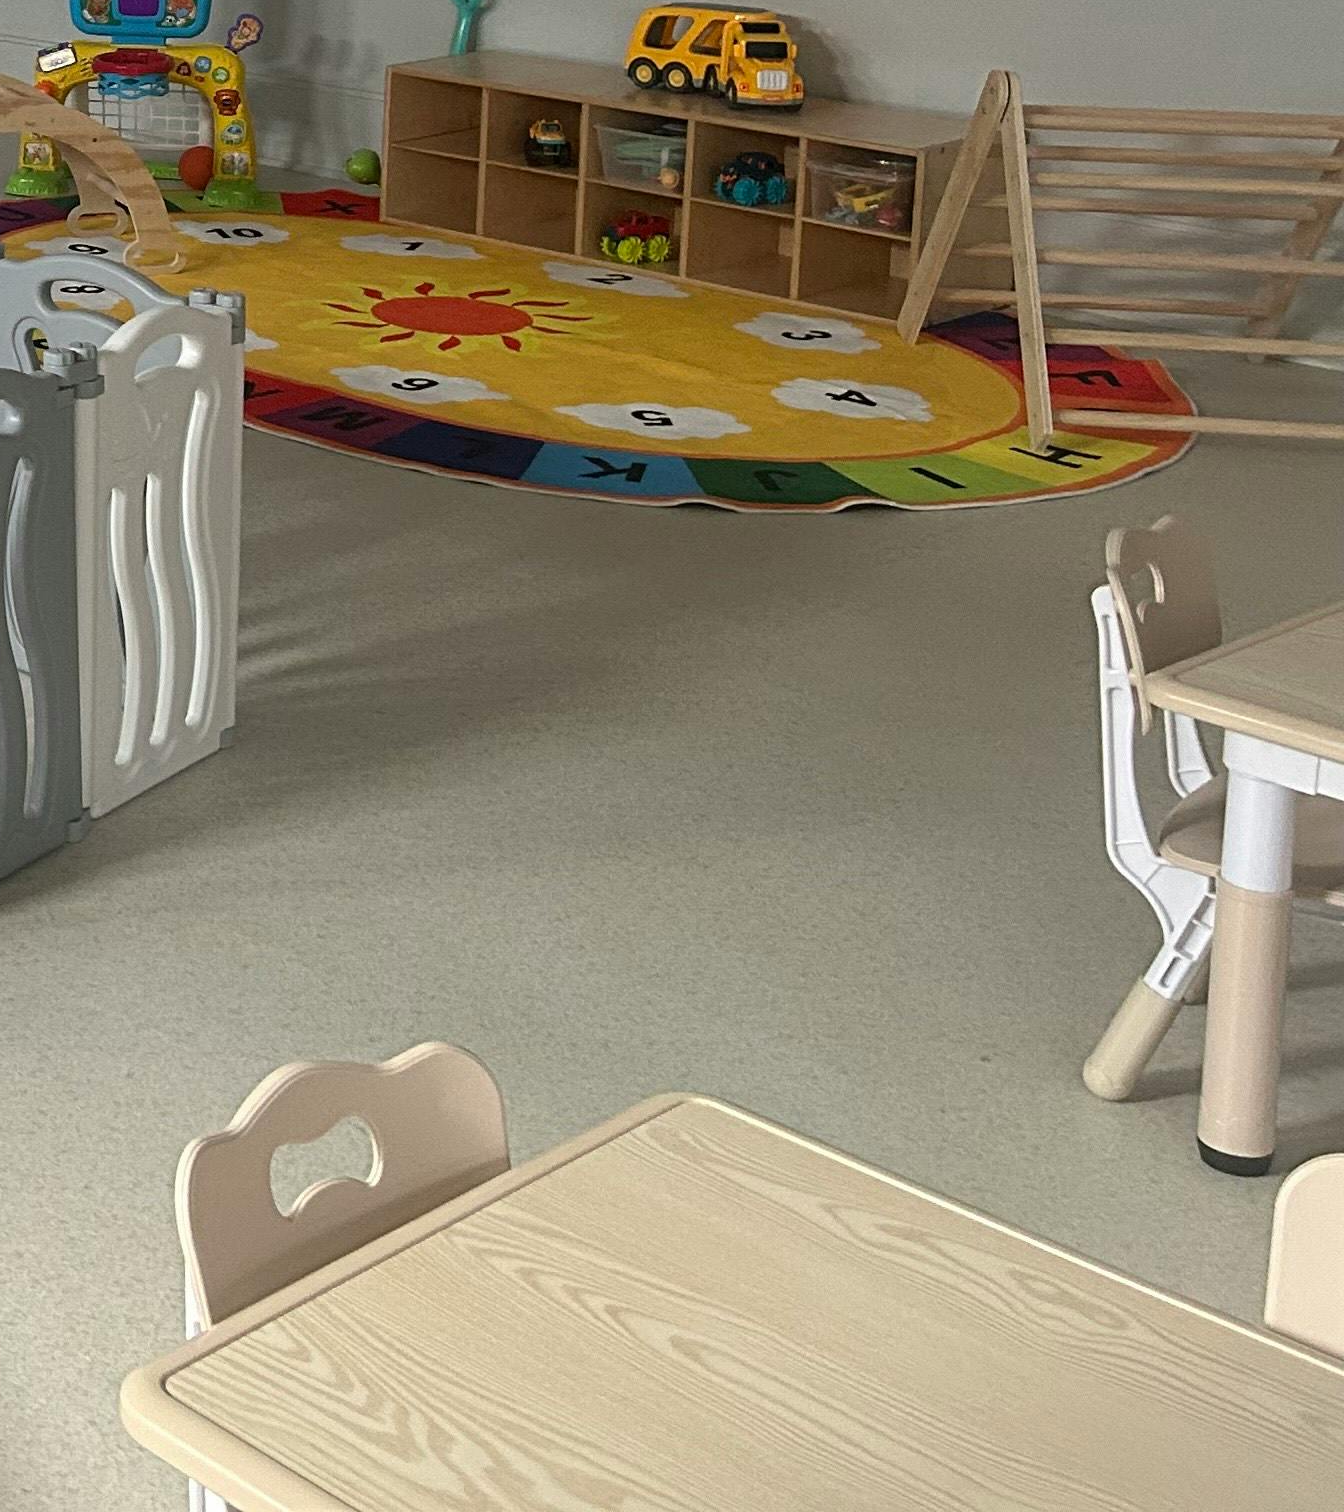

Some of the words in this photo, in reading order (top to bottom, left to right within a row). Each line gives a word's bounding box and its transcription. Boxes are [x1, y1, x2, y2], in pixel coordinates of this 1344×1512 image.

[321, 199, 364, 215] X
[206, 227, 265, 240] 10
[68, 242, 109, 256] 9
[401, 240, 426, 251] 1
[587, 273, 634, 287] 2
[60, 284, 106, 294] 8
[781, 327, 833, 343] 3
[823, 388, 878, 408] 4
[631, 408, 674, 427] 5
[577, 455, 650, 483] K
[908, 466, 968, 489] I
